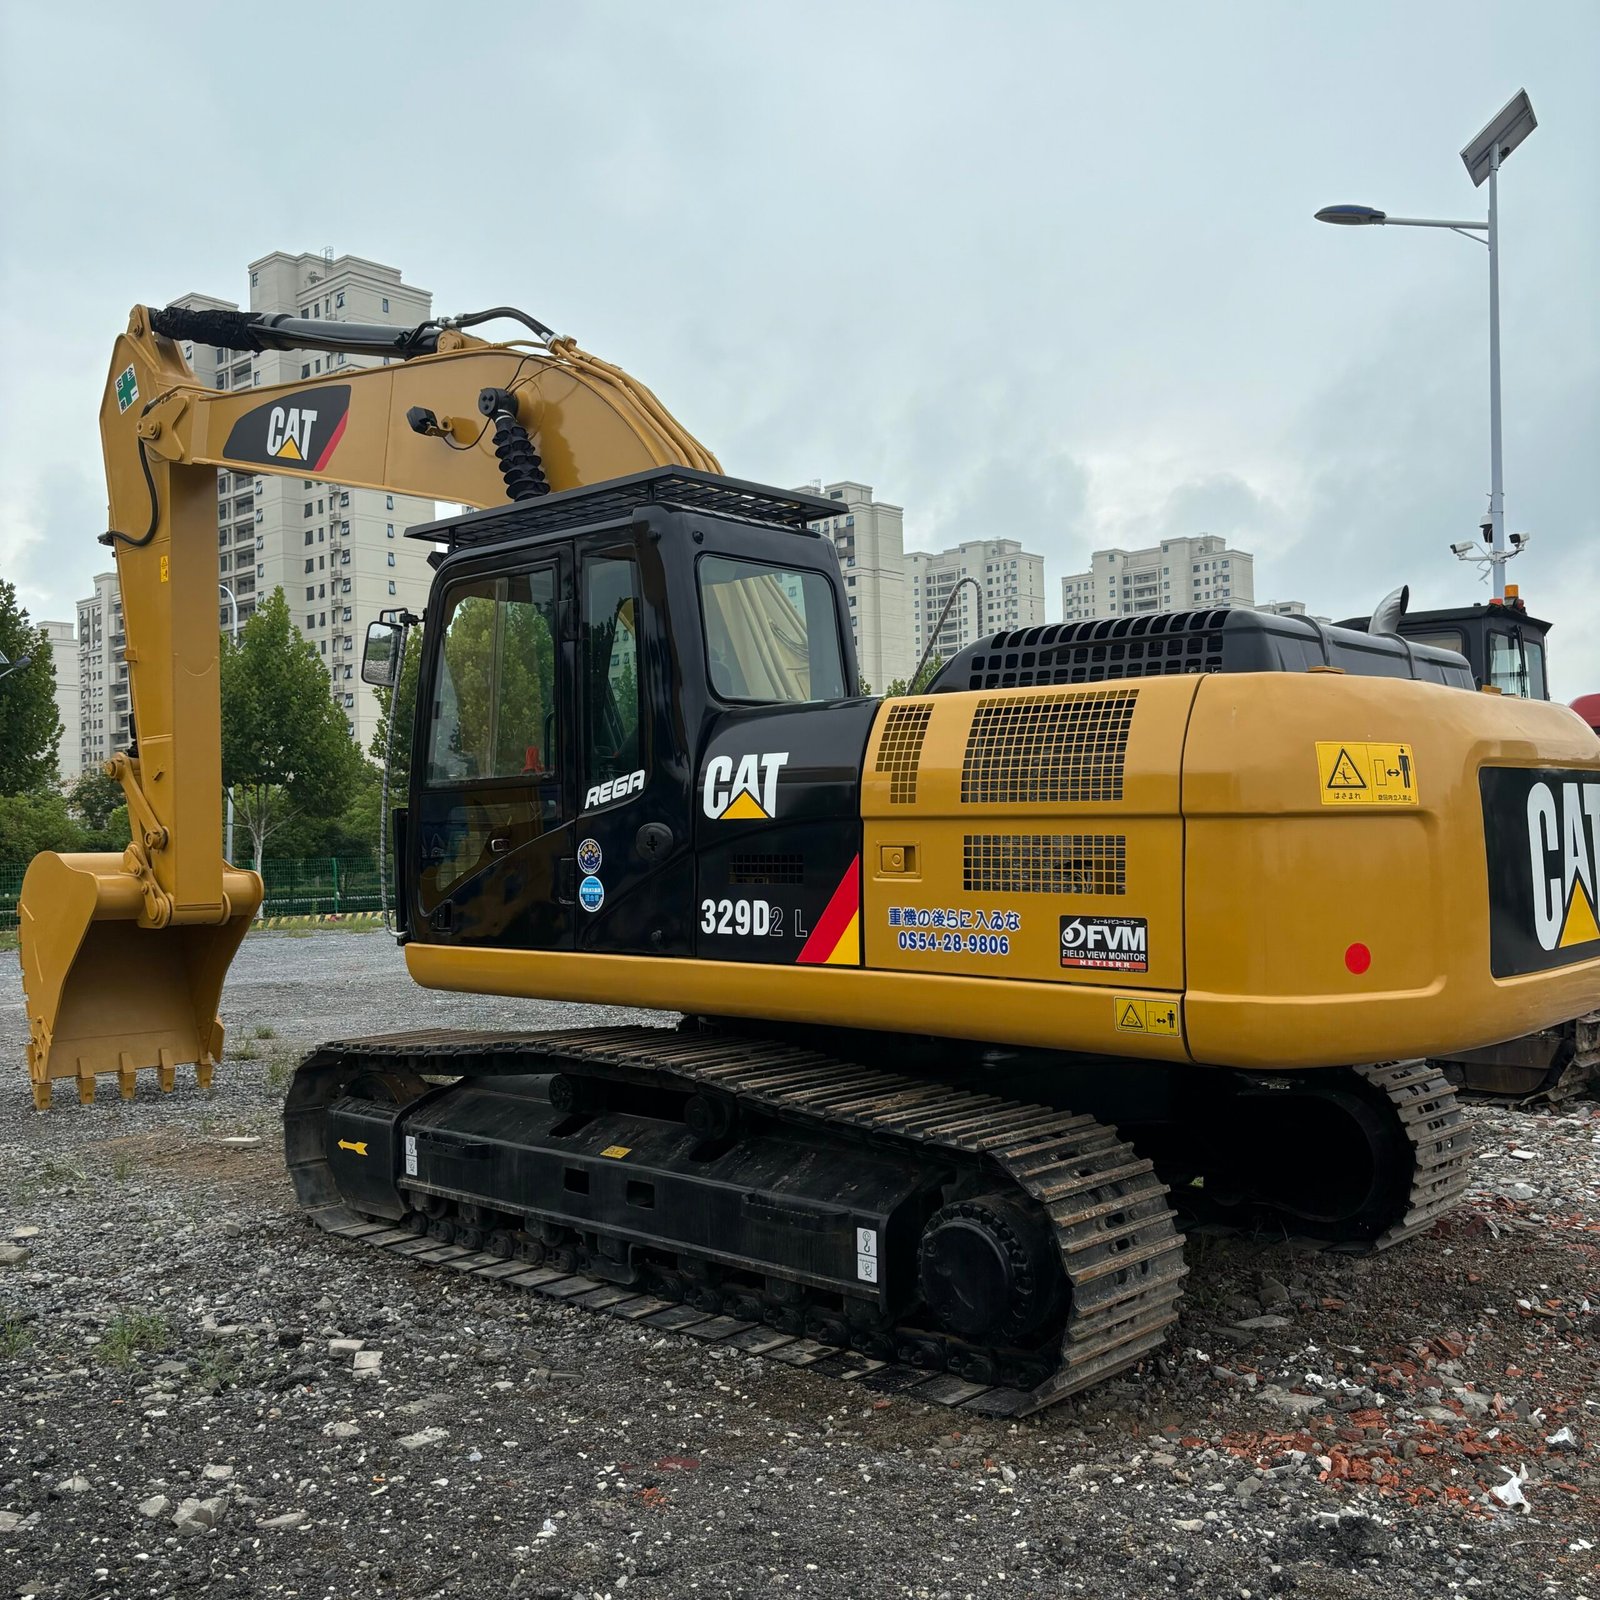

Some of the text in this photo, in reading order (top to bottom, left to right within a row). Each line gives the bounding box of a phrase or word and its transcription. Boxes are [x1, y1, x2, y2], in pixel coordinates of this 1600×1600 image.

[266, 406, 318, 461] CAT
[584, 769, 646, 809] REGA
[703, 752, 790, 820] CAT
[794, 909, 808, 938] L
[1087, 925, 1146, 951] FVM
[1062, 949, 1146, 961] FIELD VIEW MONITOR
